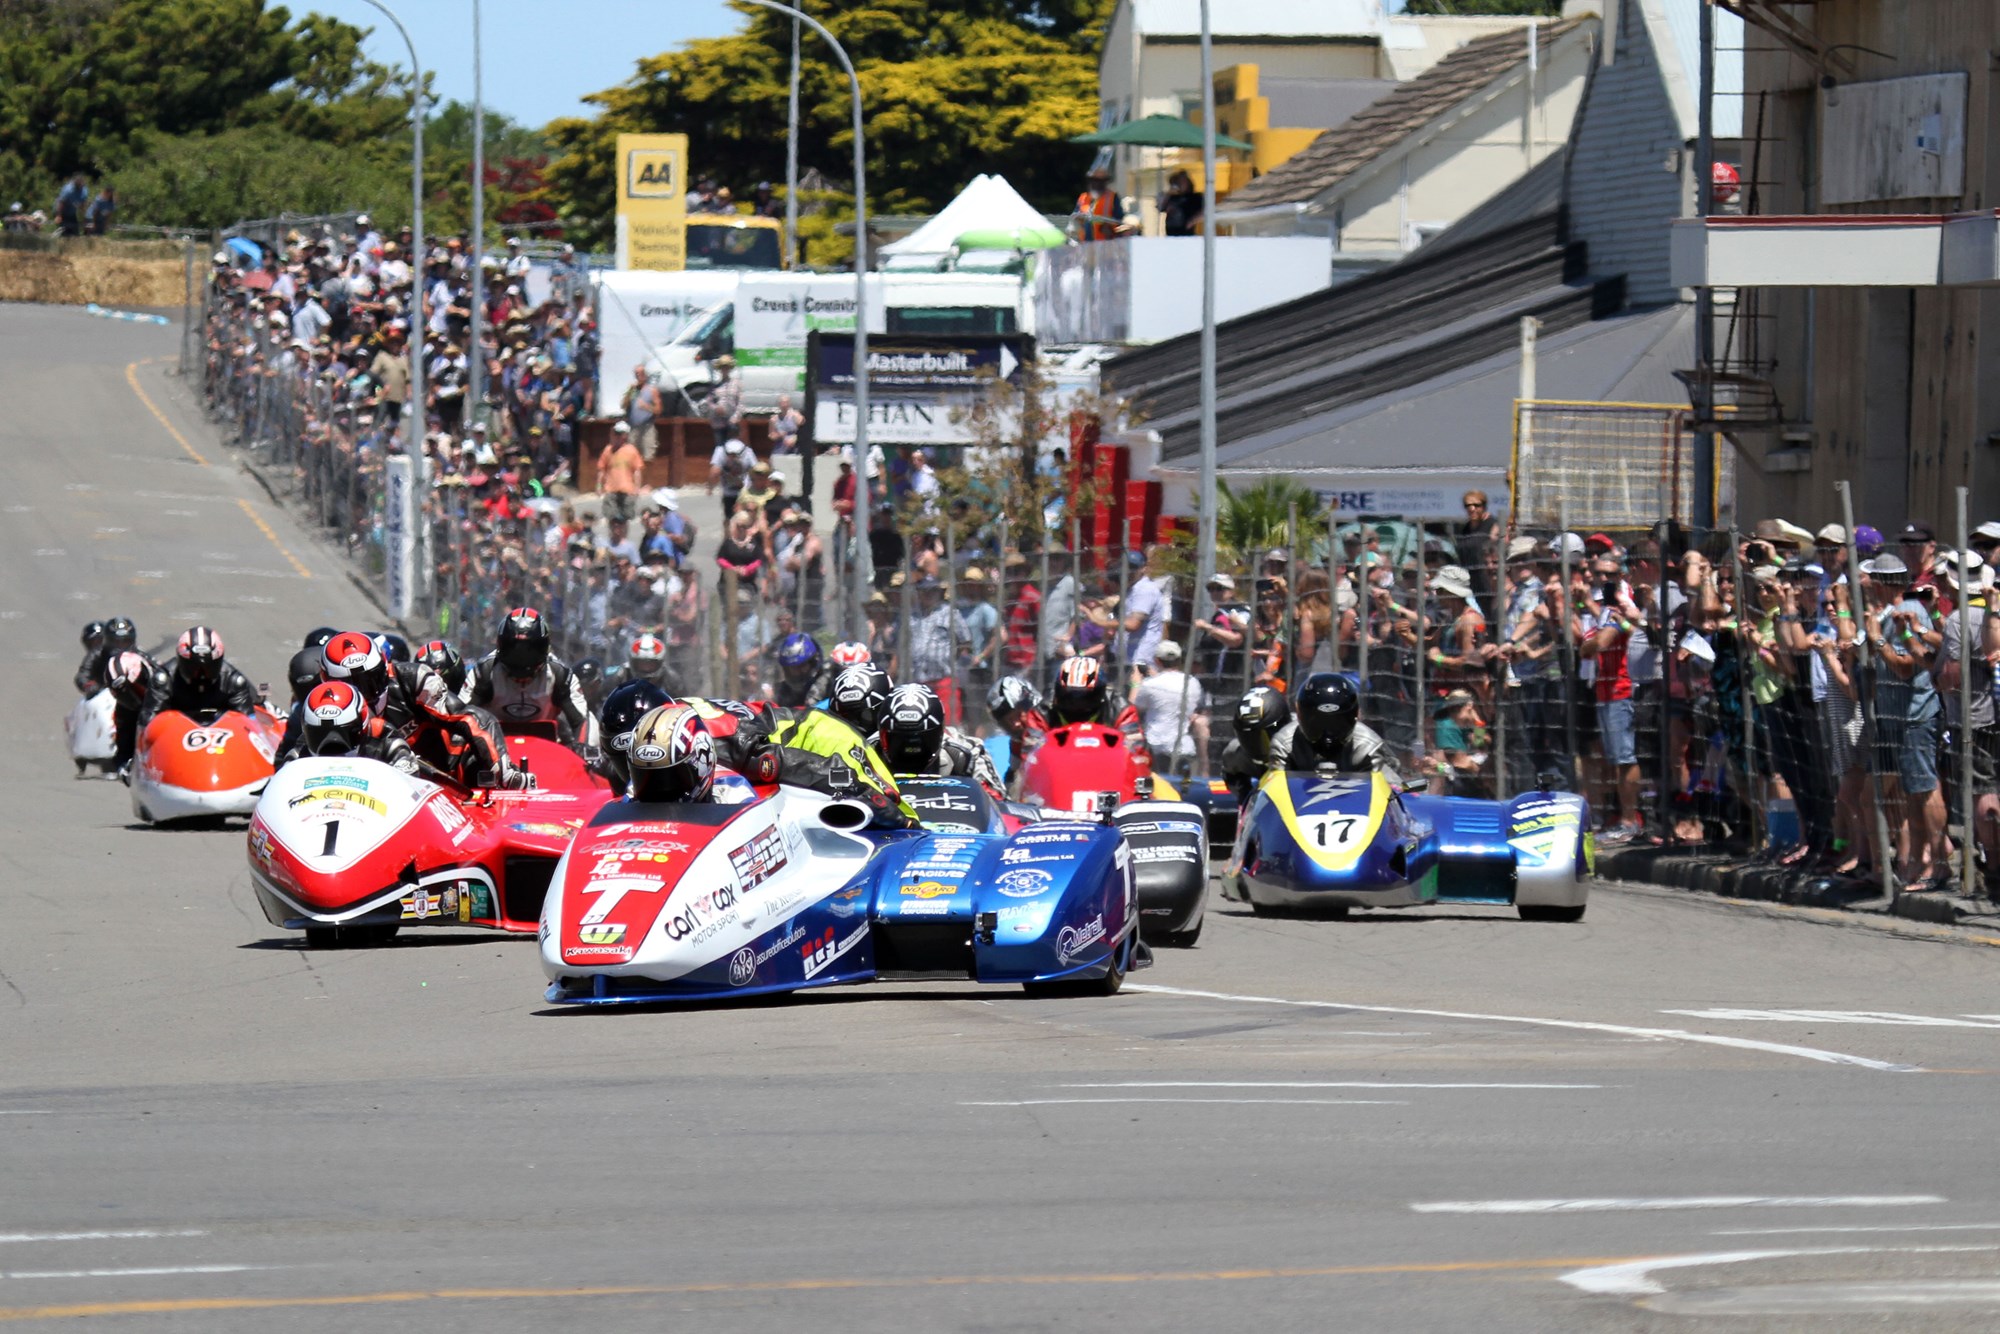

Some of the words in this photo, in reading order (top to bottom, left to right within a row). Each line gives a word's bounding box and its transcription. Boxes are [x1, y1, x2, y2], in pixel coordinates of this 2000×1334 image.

[637, 163, 671, 184] AA
[837, 401, 934, 424] EHAN
[185, 729, 231, 748] 67
[638, 749, 661, 757] Arai
[323, 789, 376, 811] eni
[313, 820, 343, 858] 1
[1314, 818, 1357, 847] 17
[592, 848, 631, 856] MOTOR
[646, 840, 691, 853] cox
[1021, 855, 1060, 863] Marketing
[607, 872, 646, 880] Marketing
[579, 879, 667, 925] T
[664, 903, 702, 941] carl
[712, 883, 739, 911] cox
[691, 926, 718, 948] MOTOR
[718, 910, 740, 930] SPORT
[565, 945, 632, 957] Kawasaki
